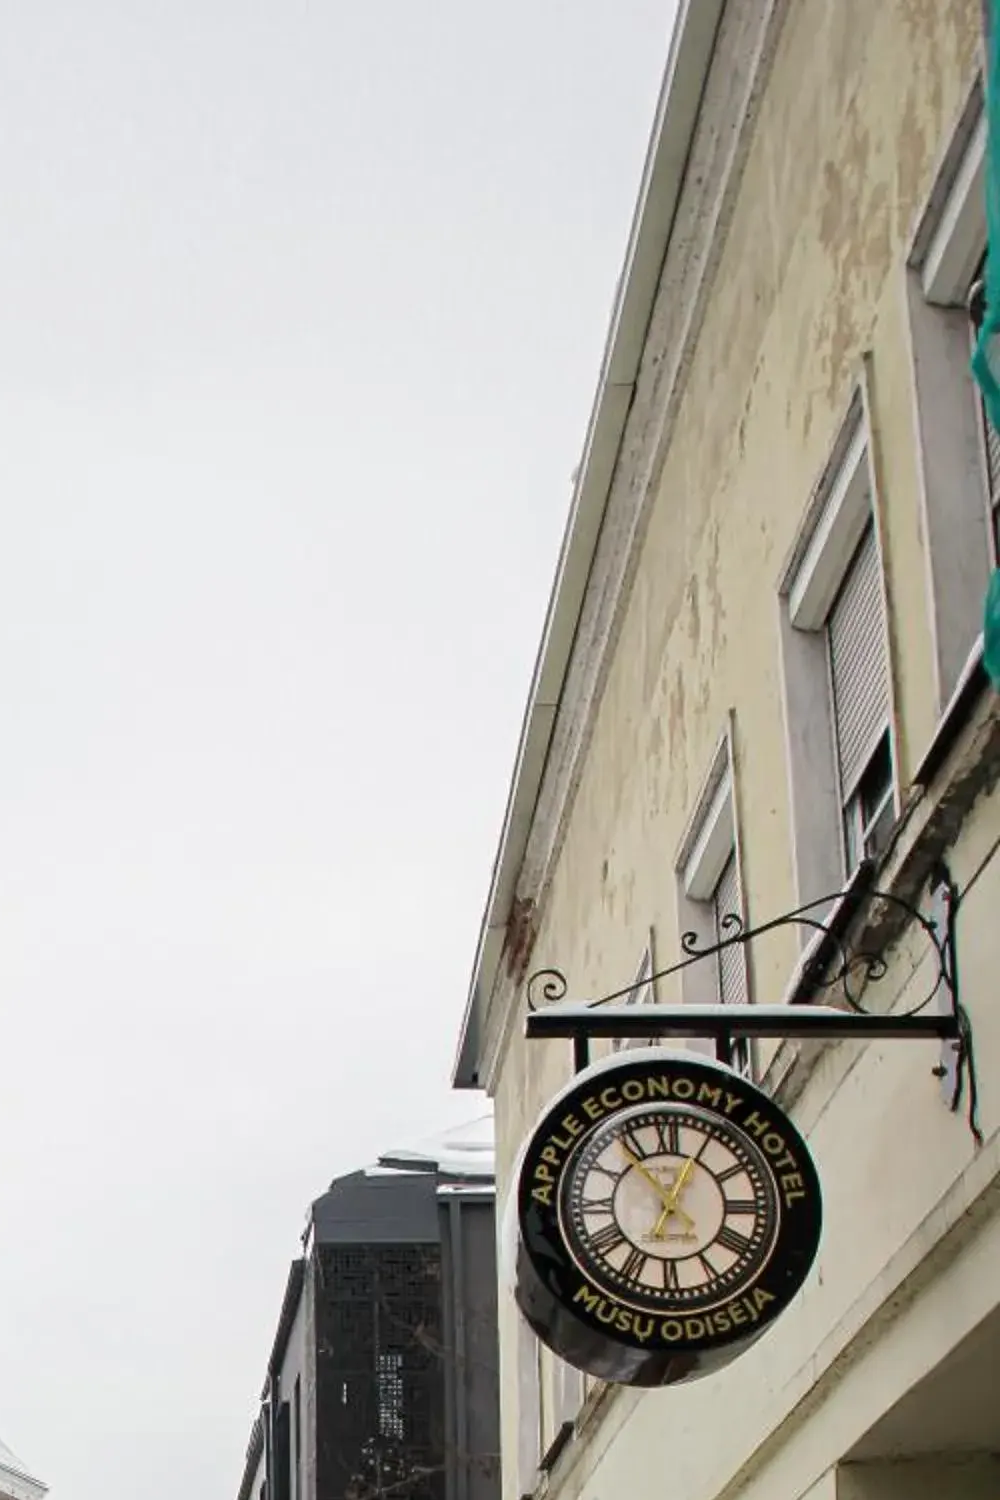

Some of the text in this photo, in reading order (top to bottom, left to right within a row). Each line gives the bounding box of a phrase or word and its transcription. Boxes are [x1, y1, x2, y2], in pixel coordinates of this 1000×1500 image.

[531, 1075, 805, 1209] APPLE ECONOMY HOTEL
